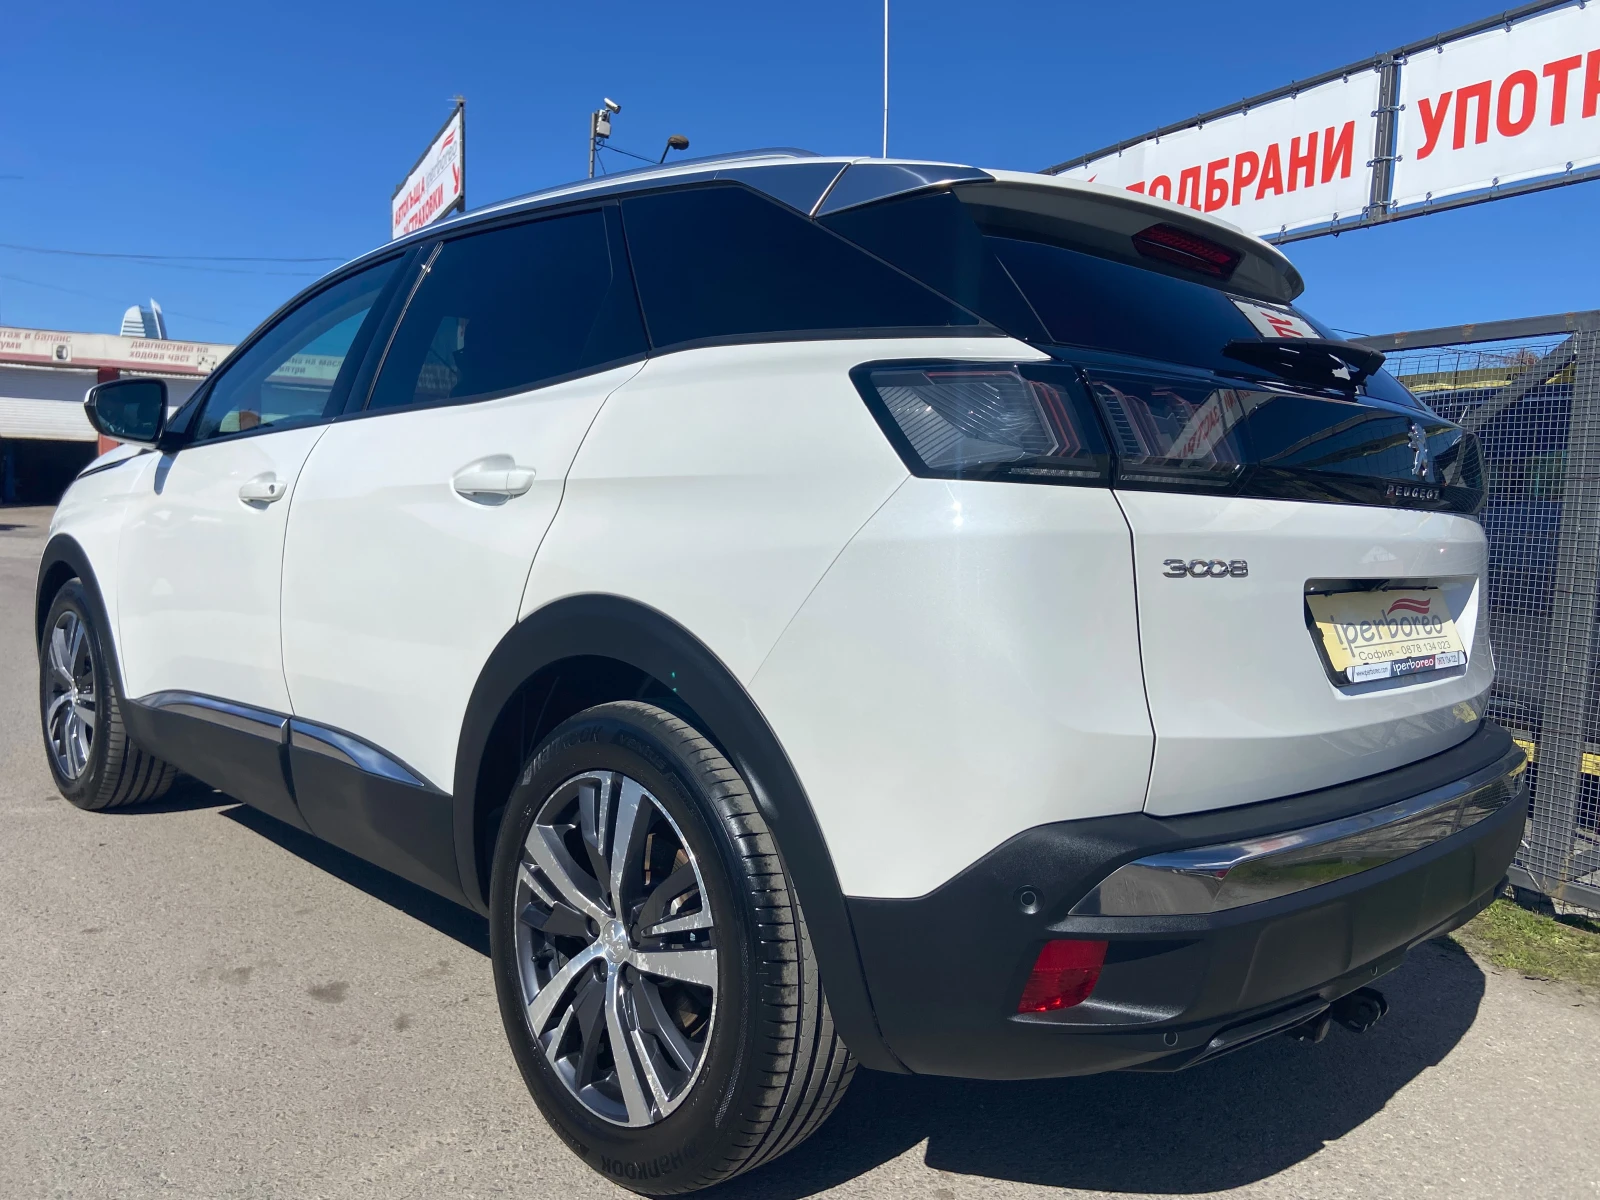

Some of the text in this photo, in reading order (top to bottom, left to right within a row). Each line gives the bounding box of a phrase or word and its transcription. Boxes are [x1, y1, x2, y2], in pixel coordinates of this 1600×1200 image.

[1125, 120, 1355, 213] ОДБРАНИ
[24, 332, 31, 340] и
[34, 331, 72, 343] баланс
[130, 340, 209, 354] диагностика на
[129, 350, 191, 363] ходова част
[1386, 484, 1440, 500] PEUGEOT
[1162, 558, 1249, 579] 3008
[1330, 610, 1443, 658] iperboreo
[1358, 650, 1394, 661] София
[1400, 644, 1422, 655] 0878
[1423, 642, 1437, 652] 134
[1437, 640, 1451, 650] 023
[1393, 658, 1434, 675] iperboreo
